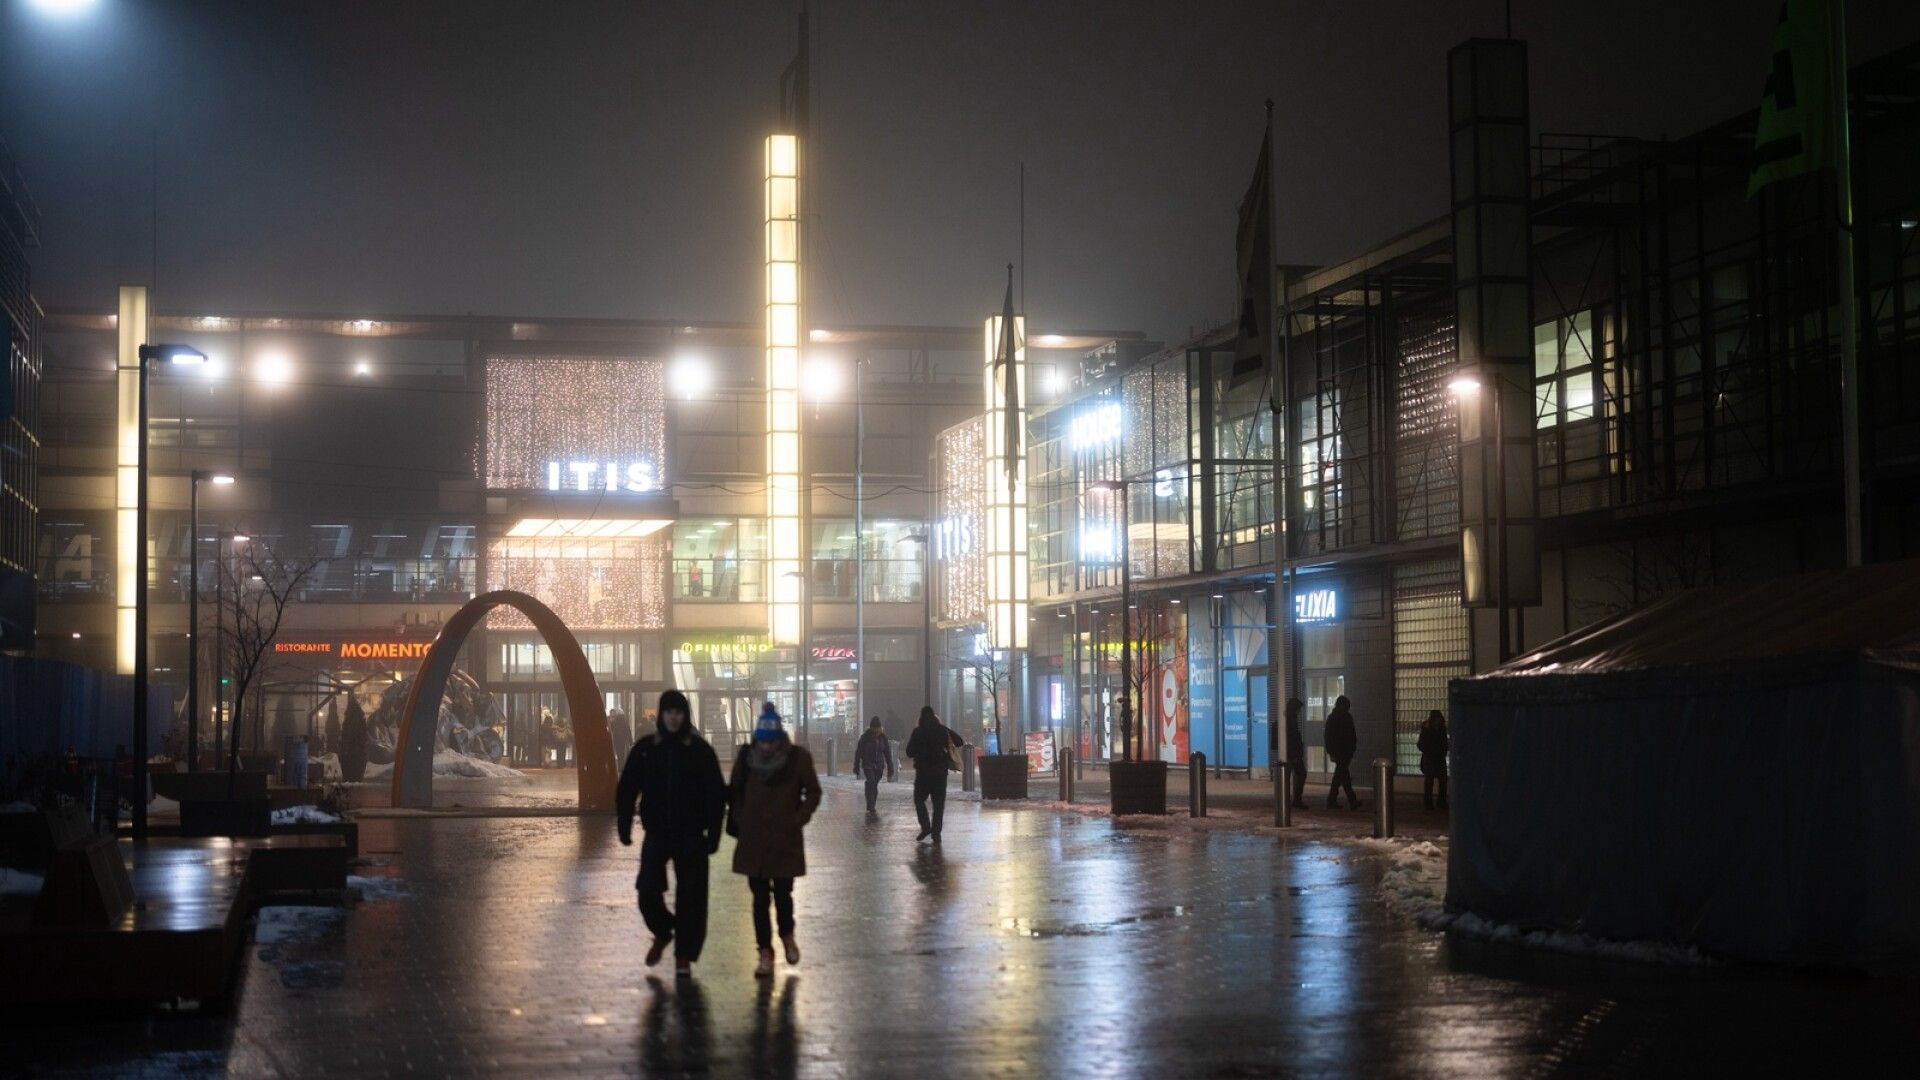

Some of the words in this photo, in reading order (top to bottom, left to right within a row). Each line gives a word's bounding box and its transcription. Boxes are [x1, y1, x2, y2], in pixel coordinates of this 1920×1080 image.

[548, 461, 653, 492] ITIS
[937, 515, 971, 560] ITIS
[275, 643, 331, 653] RISTORANTE
[695, 643, 768, 652] FINNKINO
